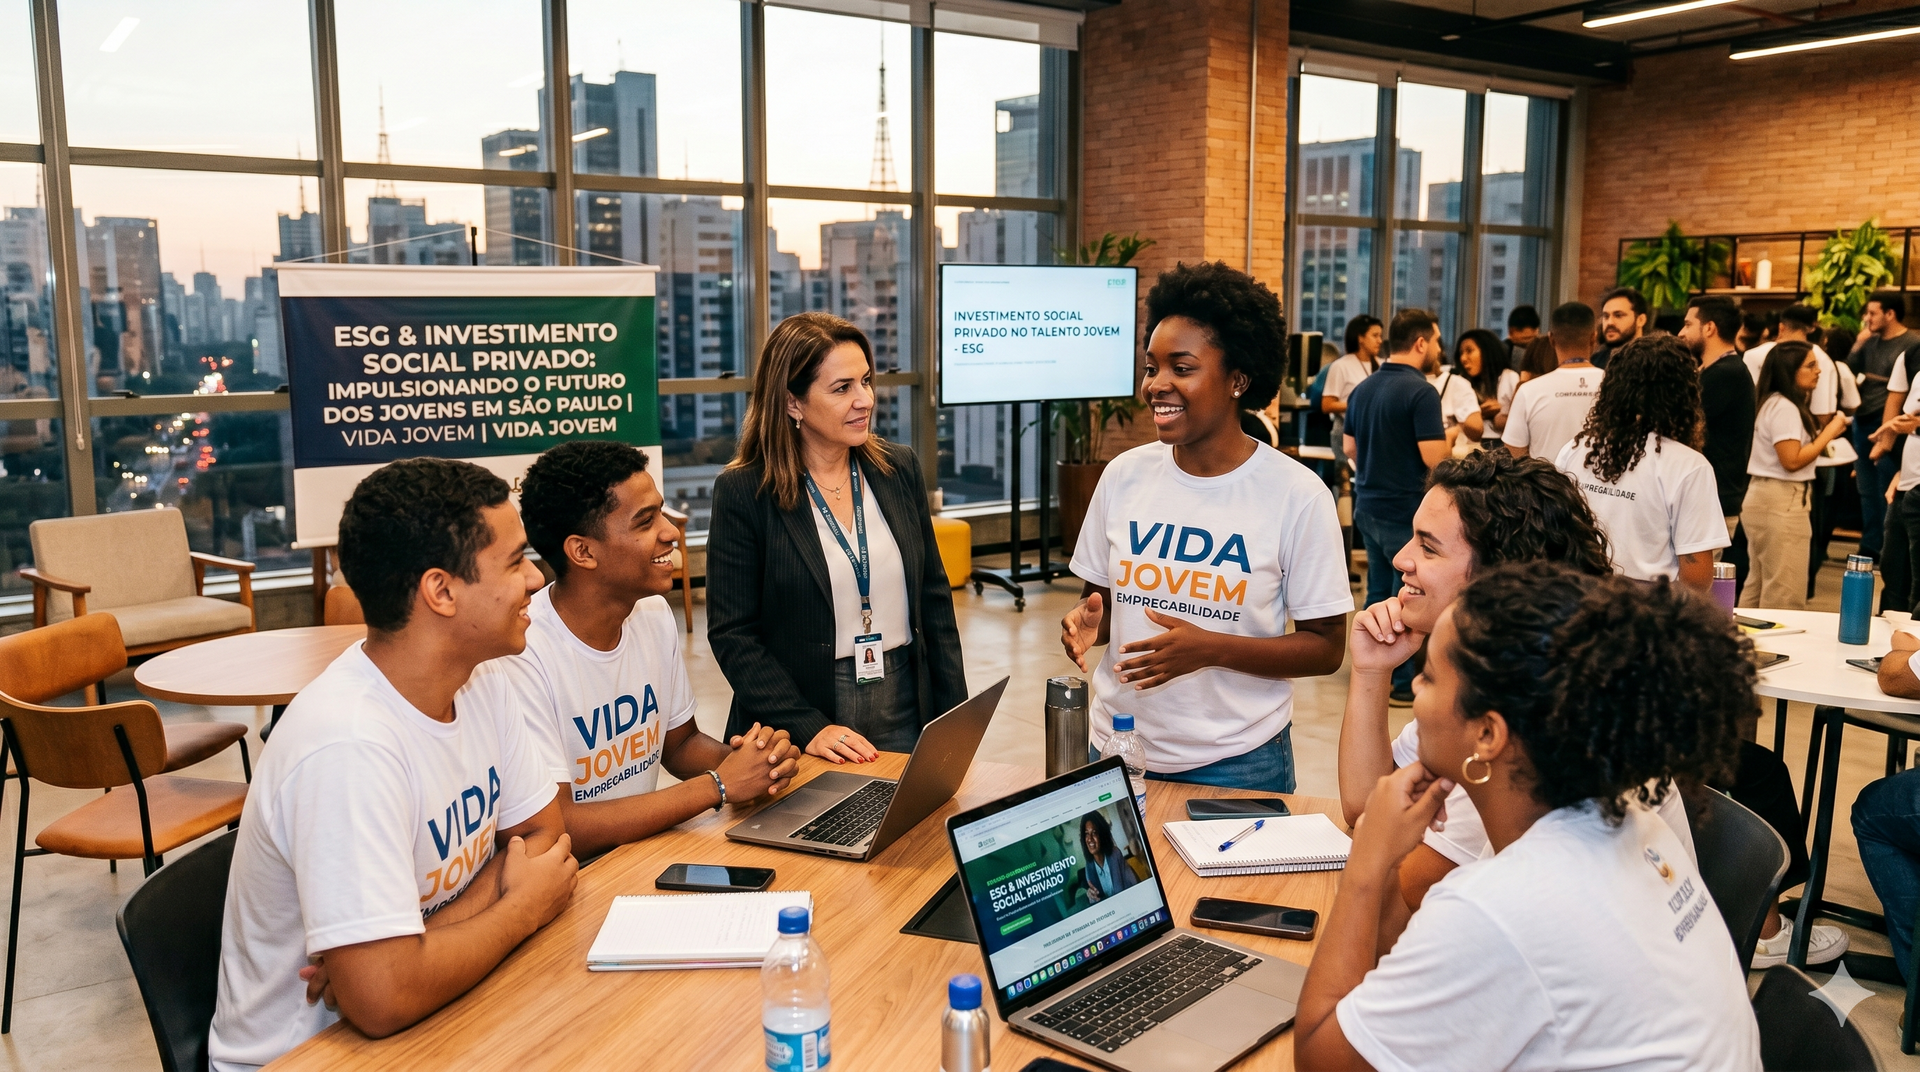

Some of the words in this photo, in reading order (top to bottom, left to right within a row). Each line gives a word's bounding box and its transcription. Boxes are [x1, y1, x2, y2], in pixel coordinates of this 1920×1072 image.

[954, 311, 1040, 322] INVESTIMENTO
[1044, 310, 1083, 321] SOCIAL
[334, 325, 390, 347] ESG
[398, 325, 417, 346] &
[425, 322, 618, 345] INVESTIMENTO
[954, 327, 1007, 338] PRIVADO
[1011, 327, 1028, 337] NO
[1031, 326, 1081, 337] TALENTO
[1083, 326, 1120, 337] JOVEM
[363, 352, 466, 374] SOCIAL
[472, 348, 596, 371] PRIVADO:
[962, 343, 984, 354] ESG
[328, 377, 519, 400] IMPULSIONANDO
[524, 376, 540, 392] O
[545, 373, 626, 392] FUTURO
[324, 405, 374, 424] DOS
[379, 402, 467, 422] JOVENS
[472, 400, 503, 417] EM
[508, 394, 552, 416] SÃO
[556, 394, 622, 412] PAULO
[341, 428, 397, 447] VIDA
[402, 424, 475, 444] JOVEM
[492, 420, 544, 438] VIDA
[548, 416, 617, 436] JOVEM
[1129, 520, 1252, 574] VIDA
[1116, 560, 1248, 606] JOVEM
[1116, 592, 1241, 622] EMPREGABILIDADE
[572, 683, 659, 750] VIDA
[574, 720, 660, 785] JOVEM
[428, 766, 500, 862] VIDA
[989, 884, 1008, 900] ESG
[1008, 882, 1016, 892] &
[1016, 855, 1076, 889] INVESTIMENTO
[992, 891, 1026, 912] SOCIAL
[1026, 873, 1064, 898] PRIVADO
